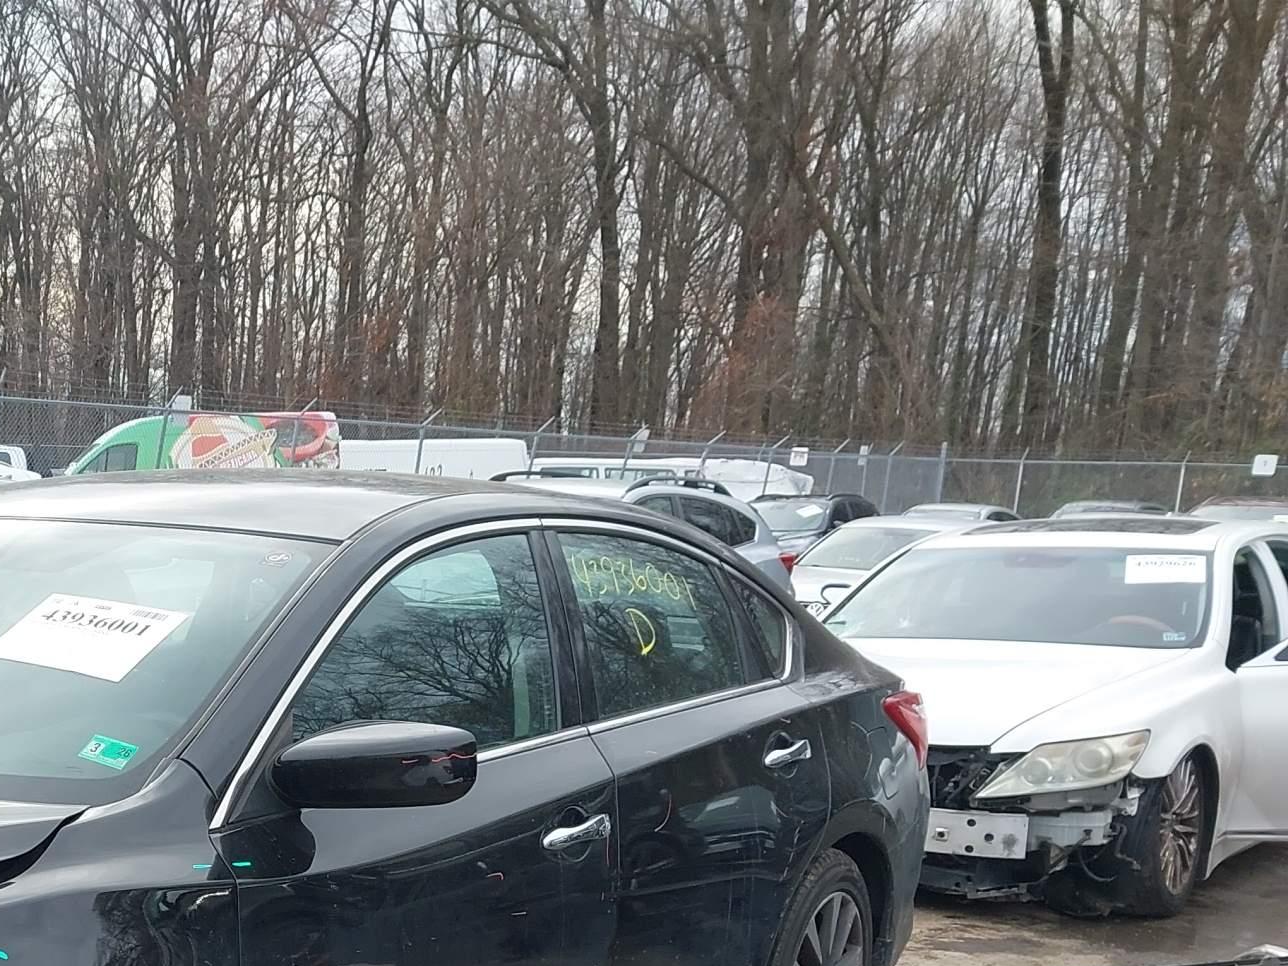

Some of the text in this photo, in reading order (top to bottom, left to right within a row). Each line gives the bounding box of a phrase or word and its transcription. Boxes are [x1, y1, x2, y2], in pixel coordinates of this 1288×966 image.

[571, 553, 697, 611] 43936001
[41, 609, 151, 636] 43936001
[624, 607, 656, 656] D
[89, 742, 101, 753] 3
